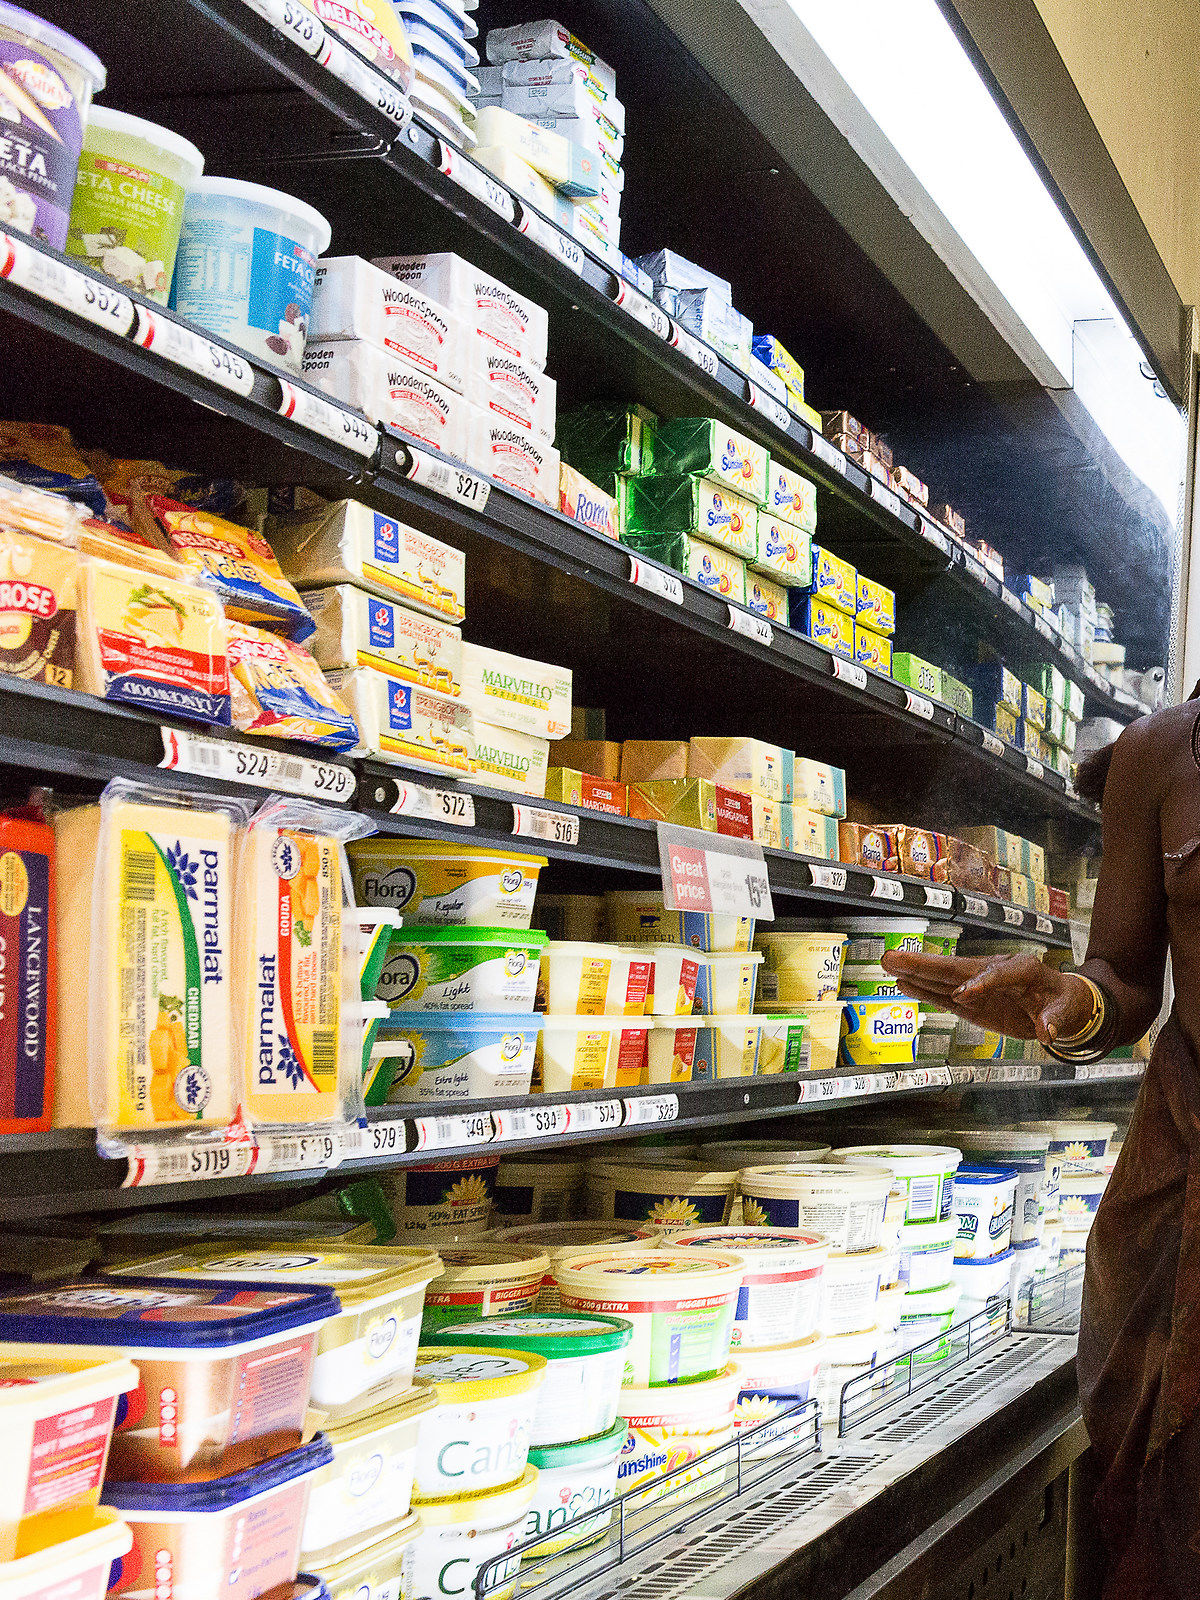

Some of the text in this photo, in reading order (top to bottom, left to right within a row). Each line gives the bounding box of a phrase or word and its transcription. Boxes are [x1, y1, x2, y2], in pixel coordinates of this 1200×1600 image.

[317, 0, 394, 58] MELROSE
[0, 138, 48, 177] ETA
[77, 170, 114, 192] ETA
[119, 182, 177, 216] CHEESE
[273, 252, 305, 277] FETA
[391, 262, 426, 271] Wooden
[395, 271, 422, 281] Spoon
[85, 279, 120, 317] $52
[212, 345, 244, 380] $45
[343, 410, 370, 442] $44
[455, 473, 480, 501] $21
[173, 532, 246, 559] MELROSE
[404, 532, 447, 559] SPRINGBOK
[0, 583, 52, 615] ROSE
[400, 615, 442, 639] SPRINGBOK
[51, 667, 67, 686] 12
[481, 669, 553, 702] MARVELLO
[122, 681, 214, 712] LANCEWOOD
[416, 695, 456, 715] SPRINGBOK
[489, 688, 546, 710] ORIGINAL
[236, 751, 269, 778] $24
[313, 768, 348, 793] $29
[441, 794, 466, 817] $72
[582, 798, 622, 815] MARGARINE
[717, 807, 749, 825] MARGARINE
[554, 823, 572, 841] $16
[863, 844, 881, 862] Rama
[912, 848, 928, 863] Rama
[672, 856, 704, 877] Great
[365, 878, 407, 899] Flora
[503, 875, 520, 887] Flora
[676, 881, 705, 901] price
[200, 849, 222, 984] parmalat
[280, 895, 291, 937] GOUDA
[435, 899, 465, 917] Regular
[24, 905, 42, 1058] LANCEWOOD
[380, 970, 412, 986] ora
[442, 982, 471, 1000] Light
[187, 986, 200, 1049] CHEDDAR
[451, 1002, 474, 1013] spread
[258, 954, 277, 1085] parmalat
[873, 1019, 914, 1036] Rama
[435, 1073, 469, 1086] Extra light
[446, 1088, 469, 1099] spread
[535, 1113, 557, 1132] $34
[599, 1106, 616, 1123] $74
[658, 1104, 675, 1121] $25
[373, 1126, 396, 1150] $79
[191, 1148, 231, 1172] $119
[463, 1158, 487, 1168] EXTRA
[429, 1208, 469, 1221] 50% FAT
[662, 1218, 684, 1226] SPAR
[426, 1294, 451, 1305] XTRA
[495, 1290, 522, 1301] BIGGER
[676, 1298, 705, 1310] BIGGER
[601, 1302, 629, 1311] EXTRA
[370, 1330, 393, 1347] Flora
[631, 1416, 659, 1428] VALUE
[616, 1453, 669, 1480] unshine
